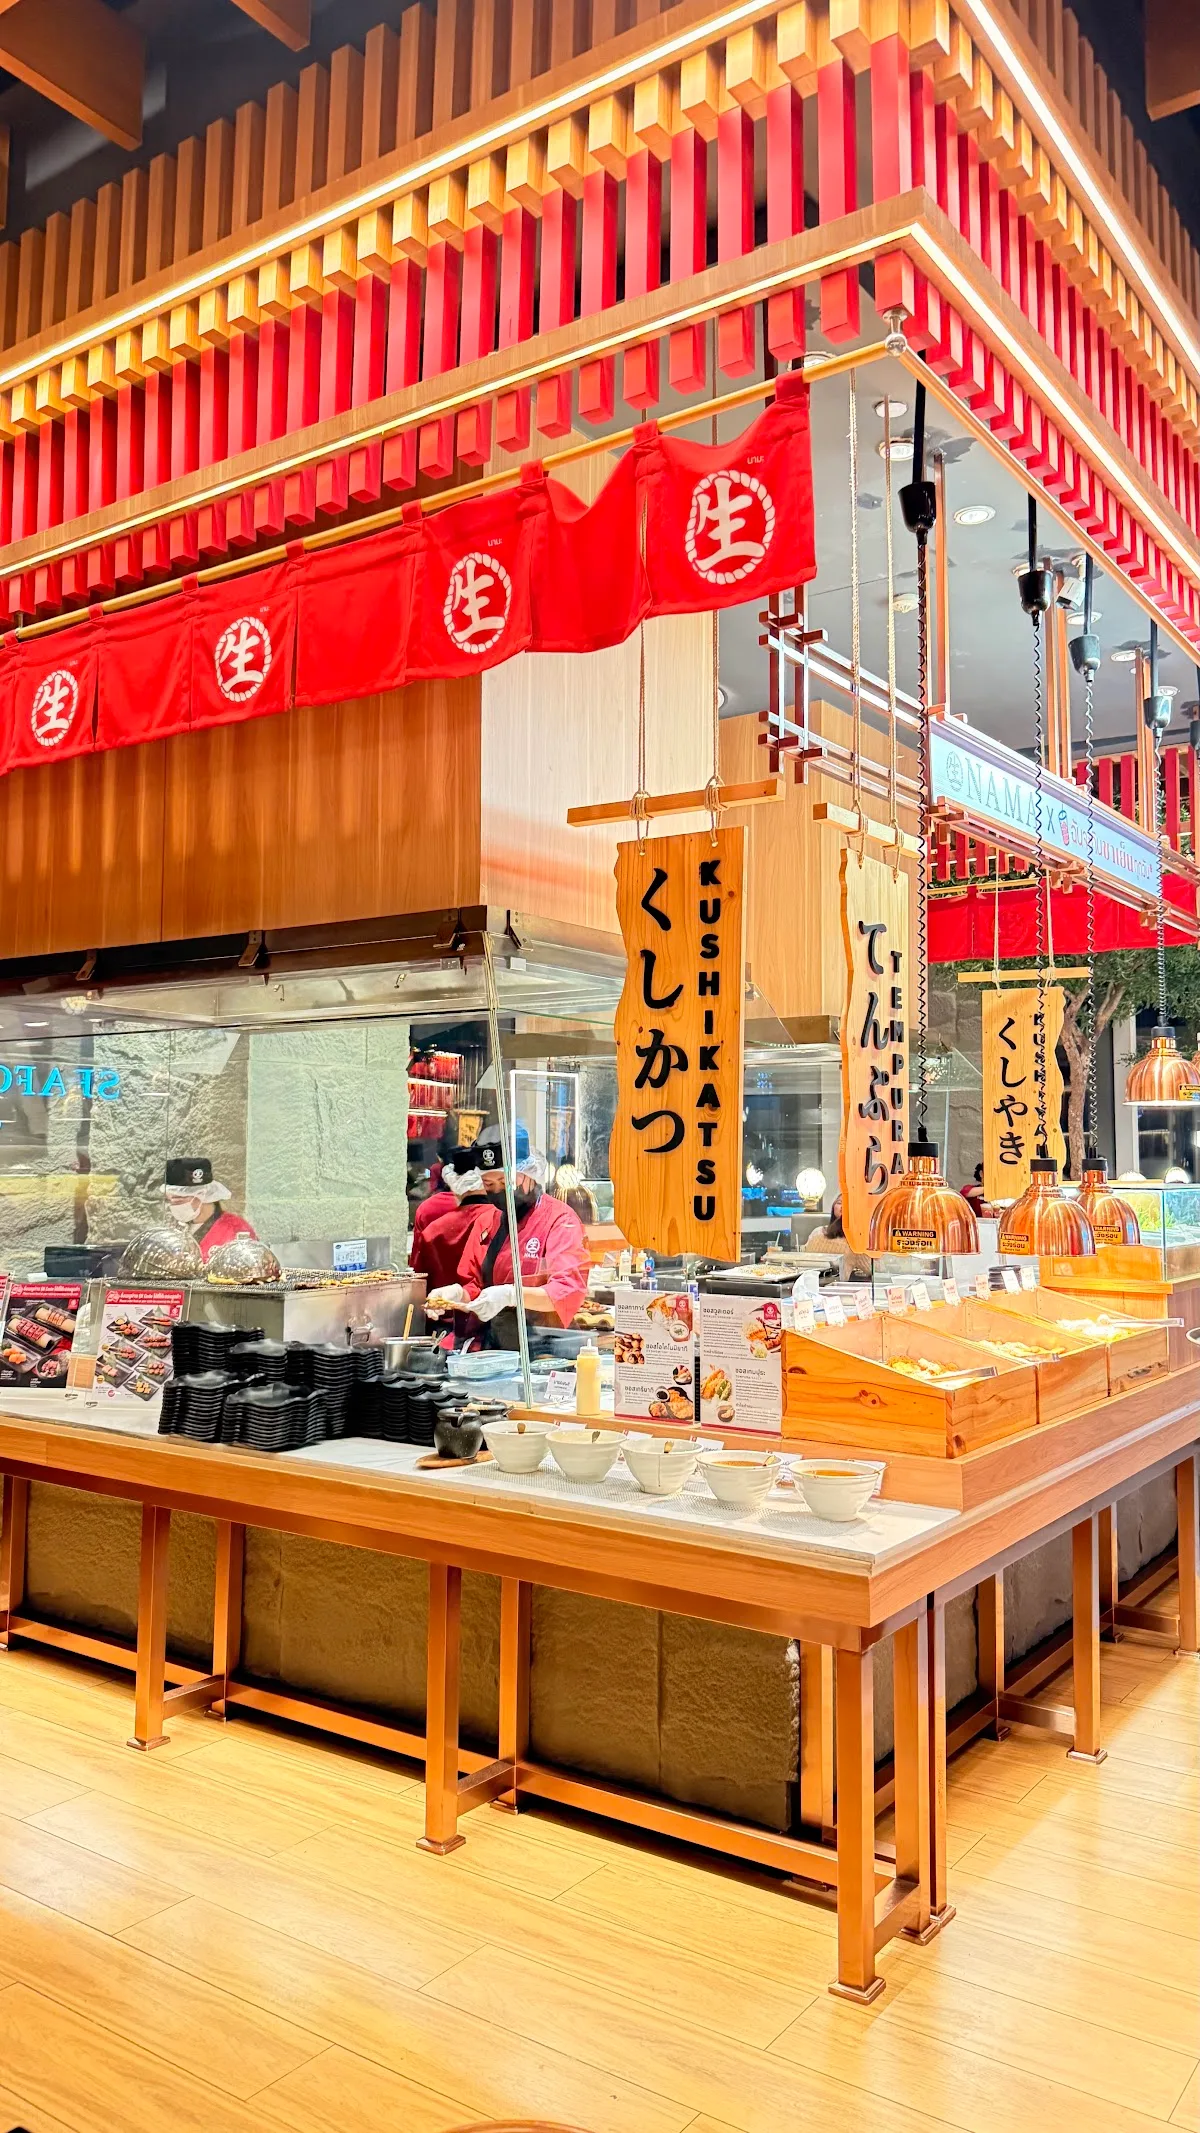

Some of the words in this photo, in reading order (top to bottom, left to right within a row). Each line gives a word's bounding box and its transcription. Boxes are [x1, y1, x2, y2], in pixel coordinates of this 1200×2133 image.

[695, 478, 765, 571] 生
[452, 558, 505, 642] 生
[220, 621, 263, 692] 生
[36, 674, 70, 737] 生
[965, 757, 1038, 829] NAMA
[631, 867, 689, 1154] くしかつ
[693, 859, 722, 1221] KUSHIKATSU
[890, 950, 905, 1175] TEMPURA
[993, 1017, 1028, 1165] くしやき
